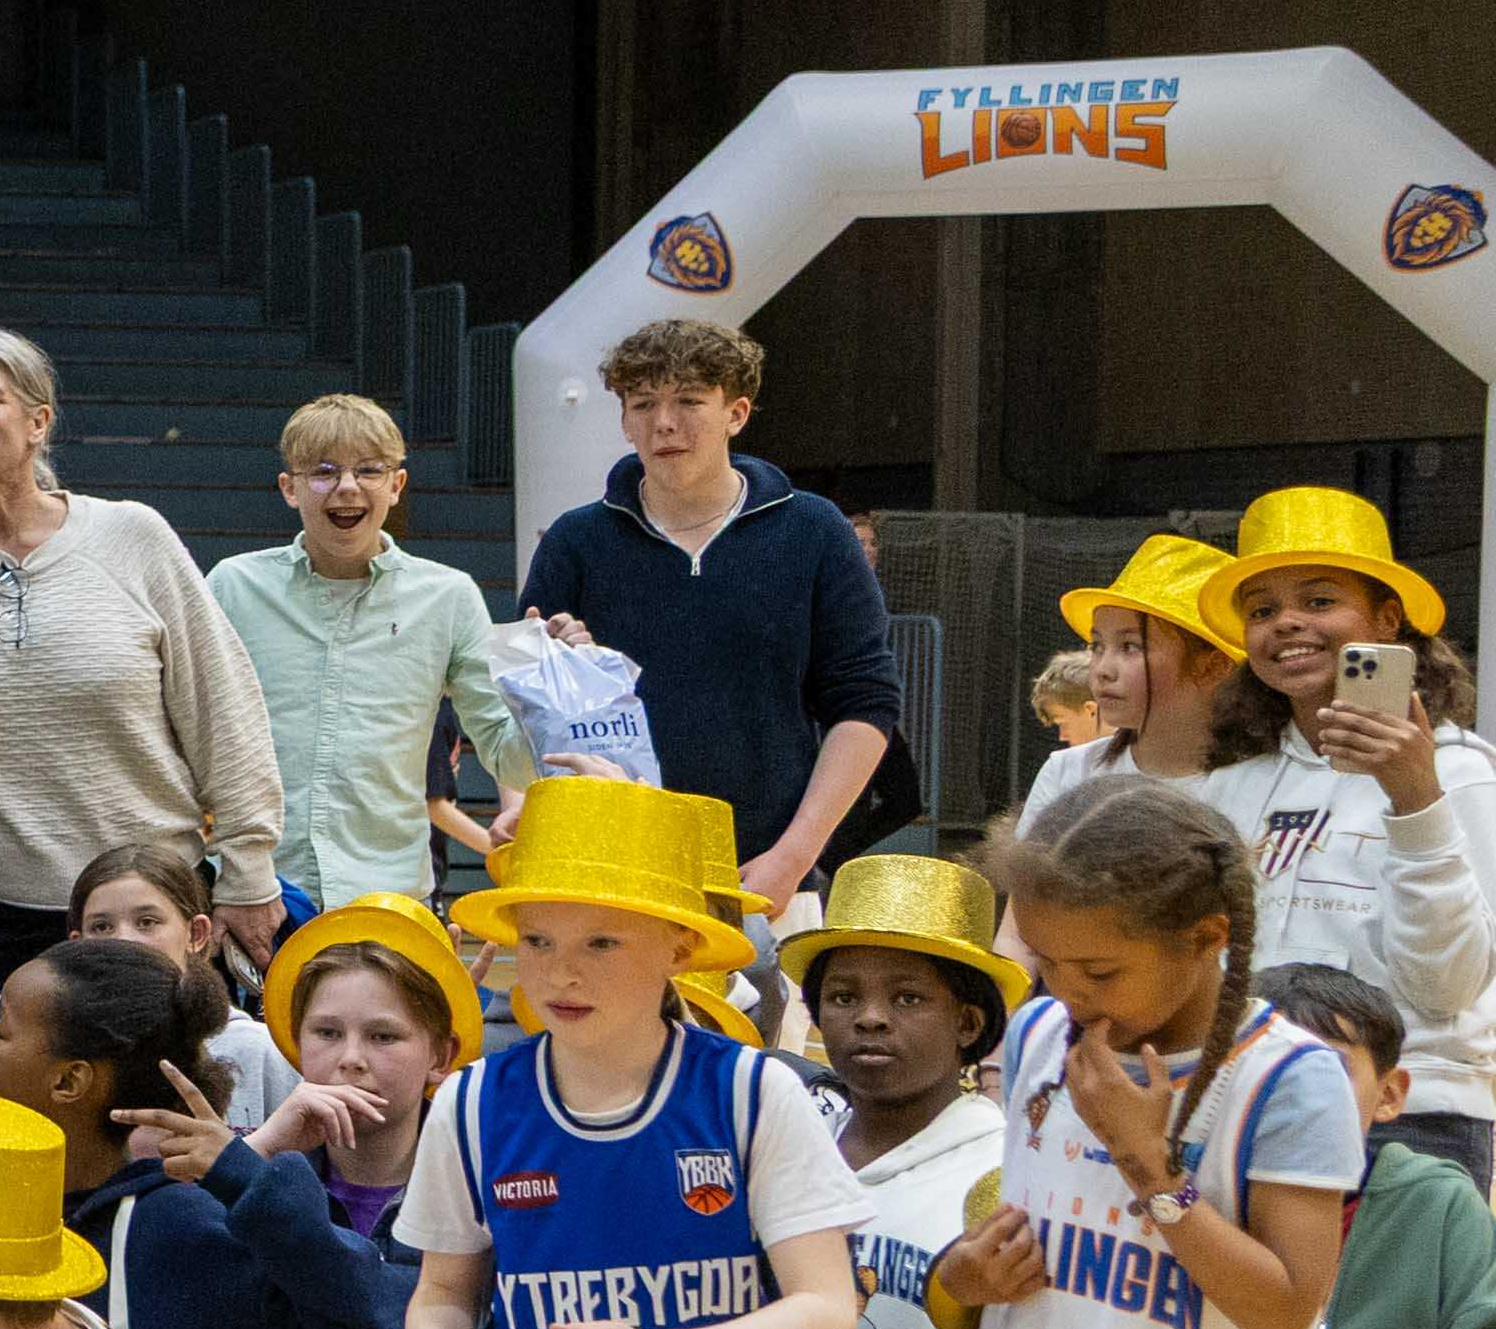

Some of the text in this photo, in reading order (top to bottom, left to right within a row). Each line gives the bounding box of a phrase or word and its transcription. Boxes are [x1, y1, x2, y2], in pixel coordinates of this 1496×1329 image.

[917, 77, 1180, 112] FYLLINGEN
[913, 100, 1178, 180] LIONS
[569, 712, 640, 740] norli
[493, 1178, 559, 1201] VICTORIA
